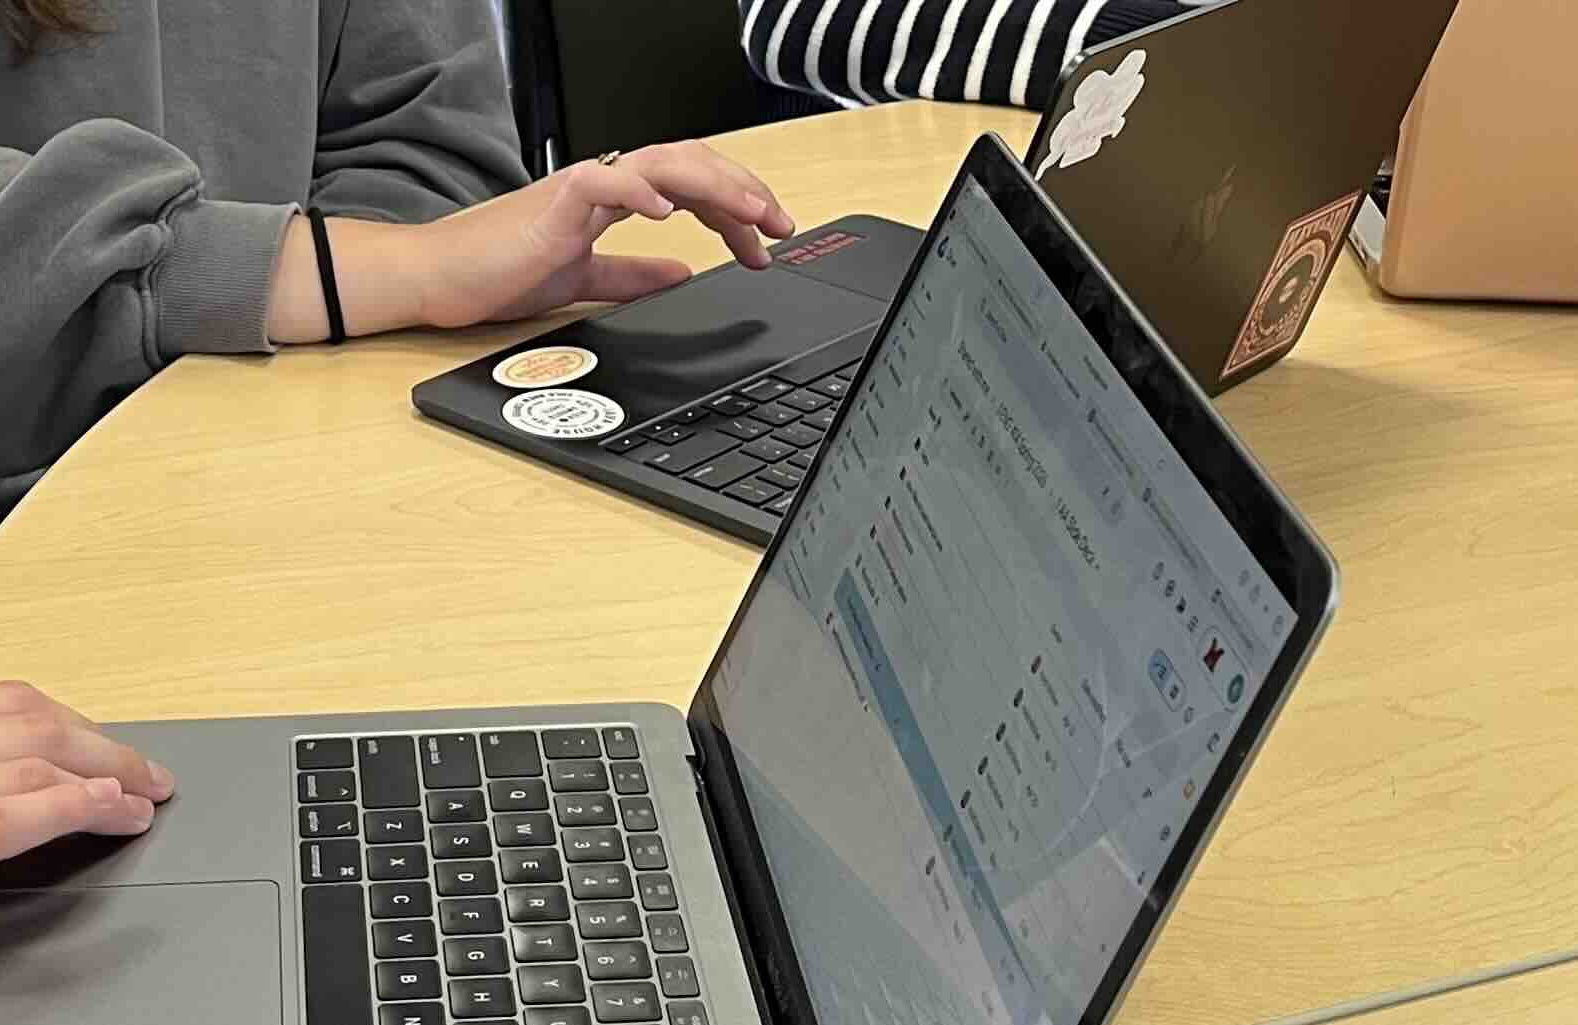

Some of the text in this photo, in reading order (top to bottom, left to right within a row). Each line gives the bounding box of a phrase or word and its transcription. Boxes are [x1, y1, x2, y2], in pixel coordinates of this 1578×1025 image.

[510, 790, 526, 799] Q
[448, 801, 464, 810] A
[386, 821, 402, 830] Z
[516, 823, 533, 834] W
[453, 837, 469, 845] S
[574, 840, 590, 849] 3
[390, 857, 406, 866] X
[522, 861, 539, 869] E
[458, 873, 474, 881] D
[393, 895, 410, 904] C
[529, 898, 545, 907] R
[463, 911, 479, 919] F
[589, 916, 606, 924] 5
[397, 934, 414, 943] V
[535, 938, 553, 946] T
[468, 951, 485, 960] G
[597, 956, 614, 965] 6
[400, 975, 418, 983] B
[543, 979, 559, 988] Y
[473, 992, 491, 1002] H
